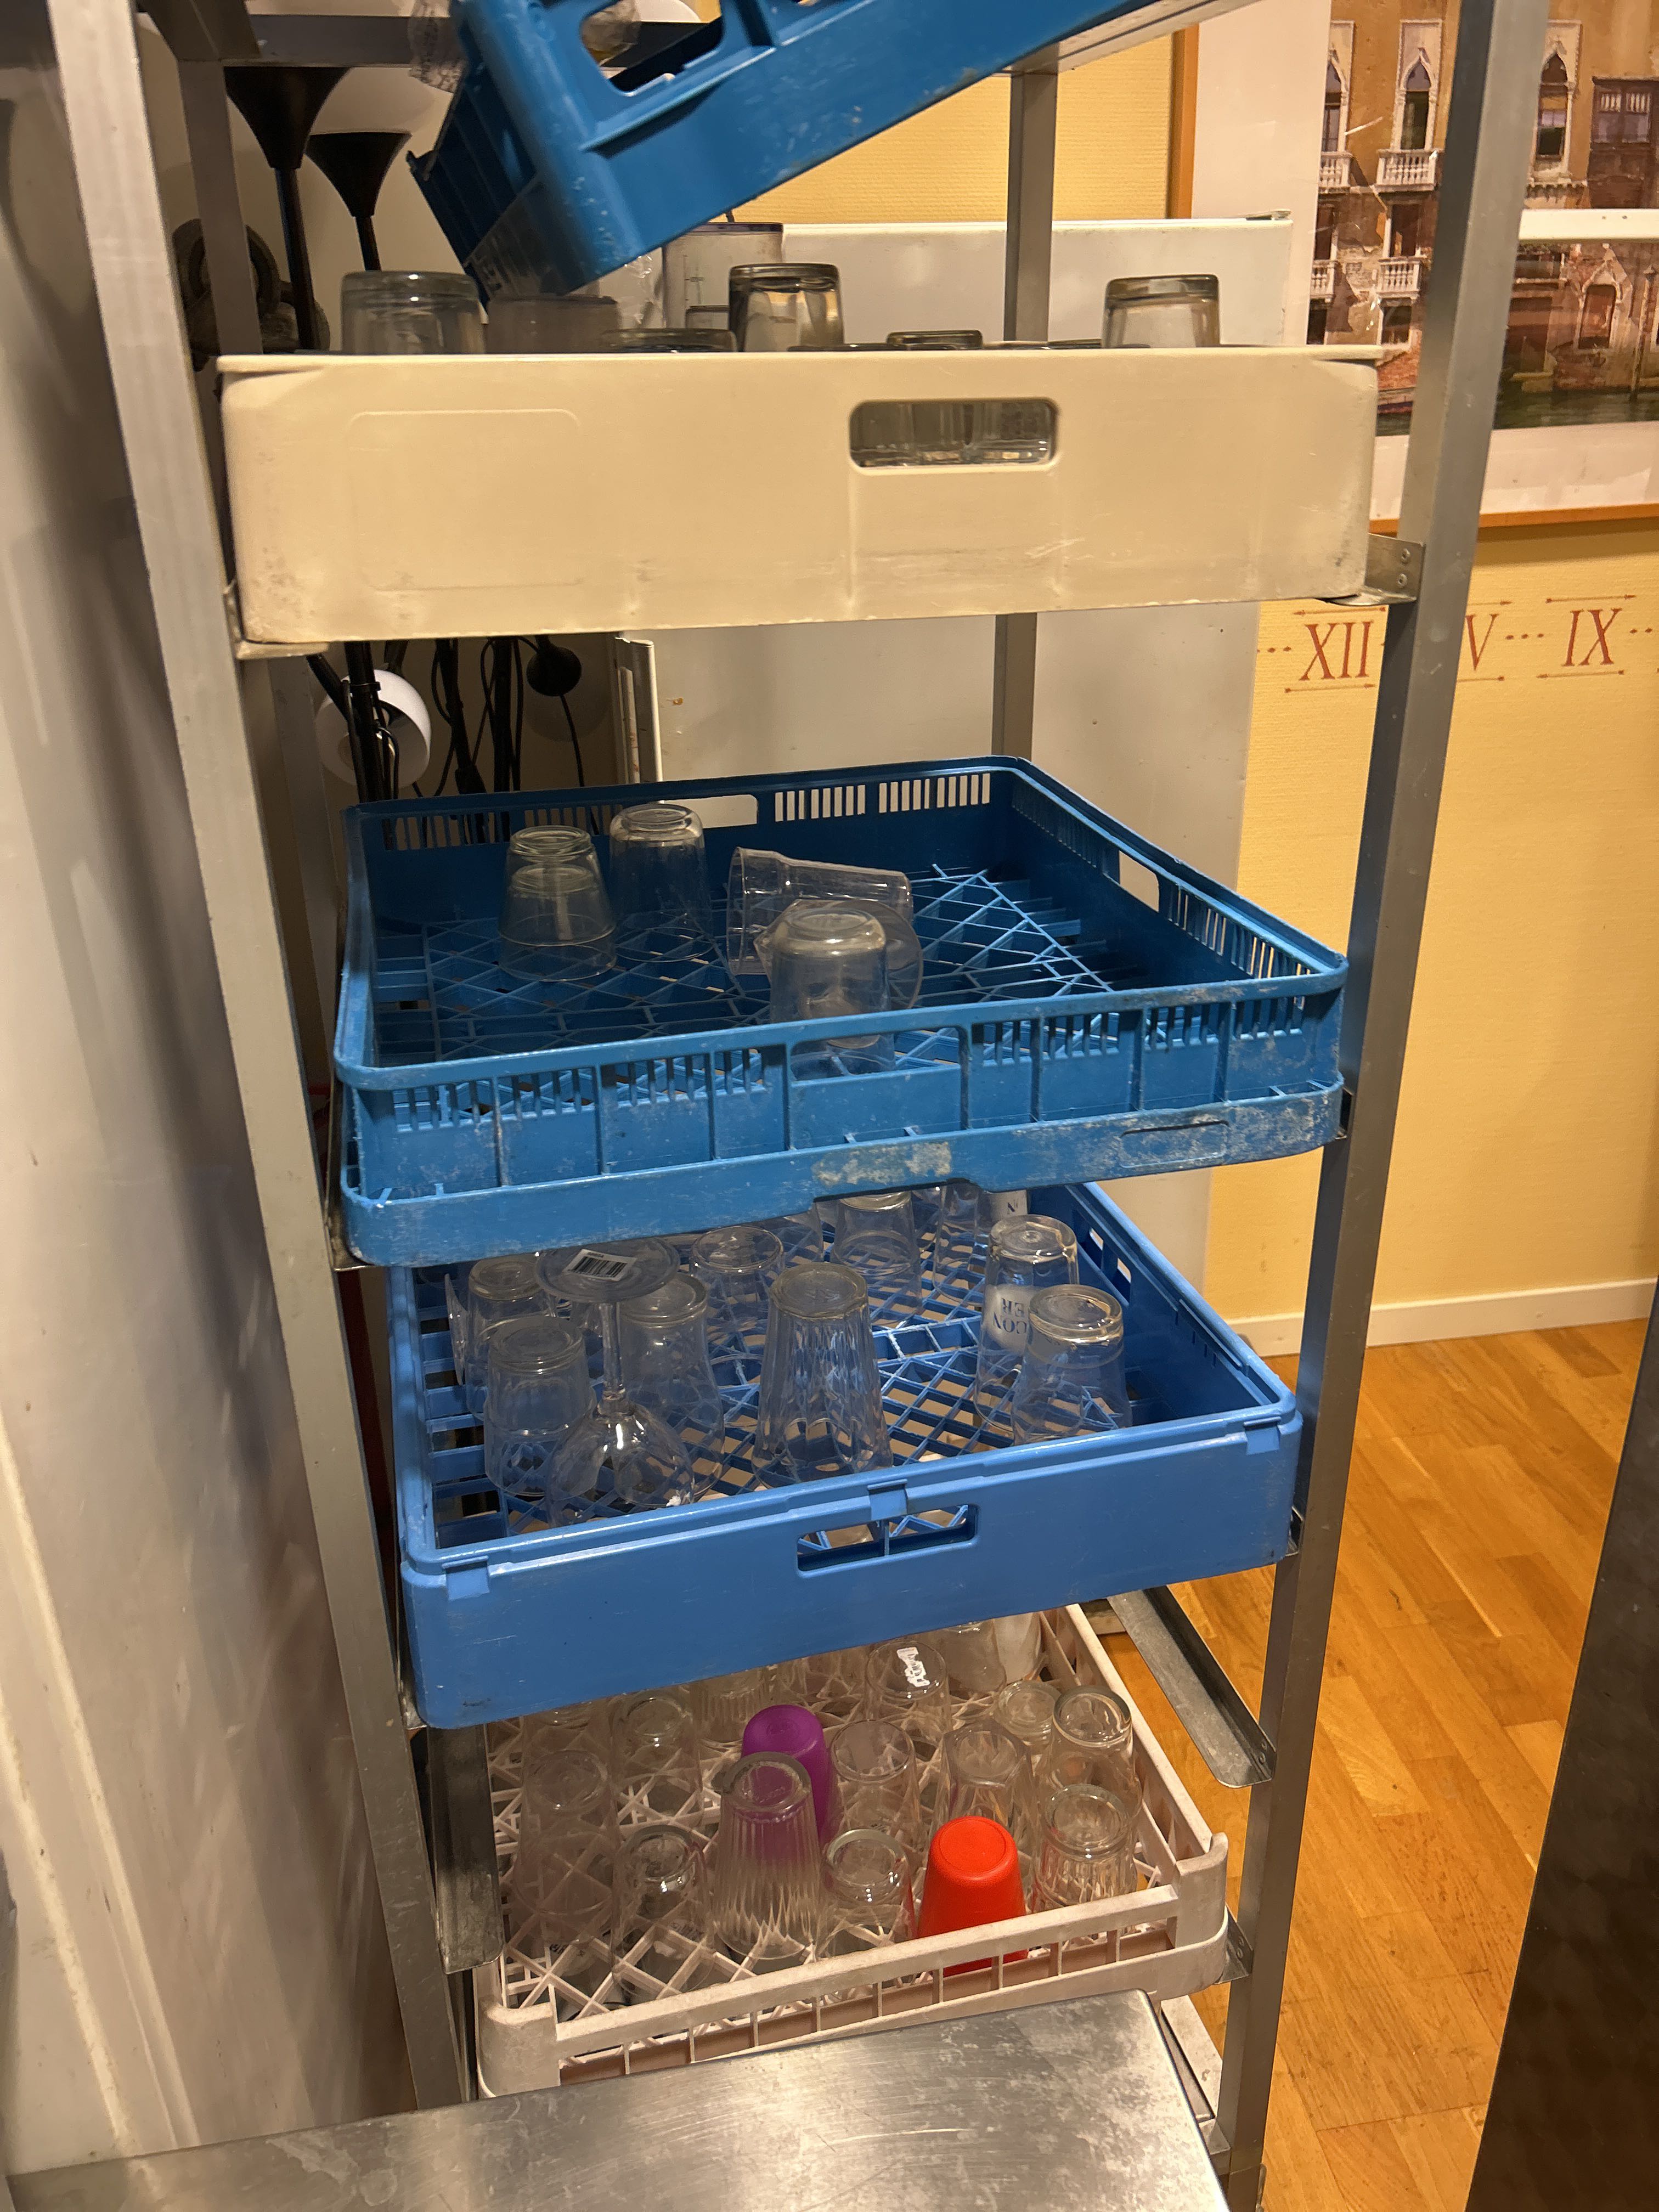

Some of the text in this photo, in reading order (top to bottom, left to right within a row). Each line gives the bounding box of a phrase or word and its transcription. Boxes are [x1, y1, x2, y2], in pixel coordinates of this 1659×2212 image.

[1299, 607, 1623, 681] XII V IX
[1001, 1297, 1025, 1317] ER
[992, 1311, 1028, 1335] CON
